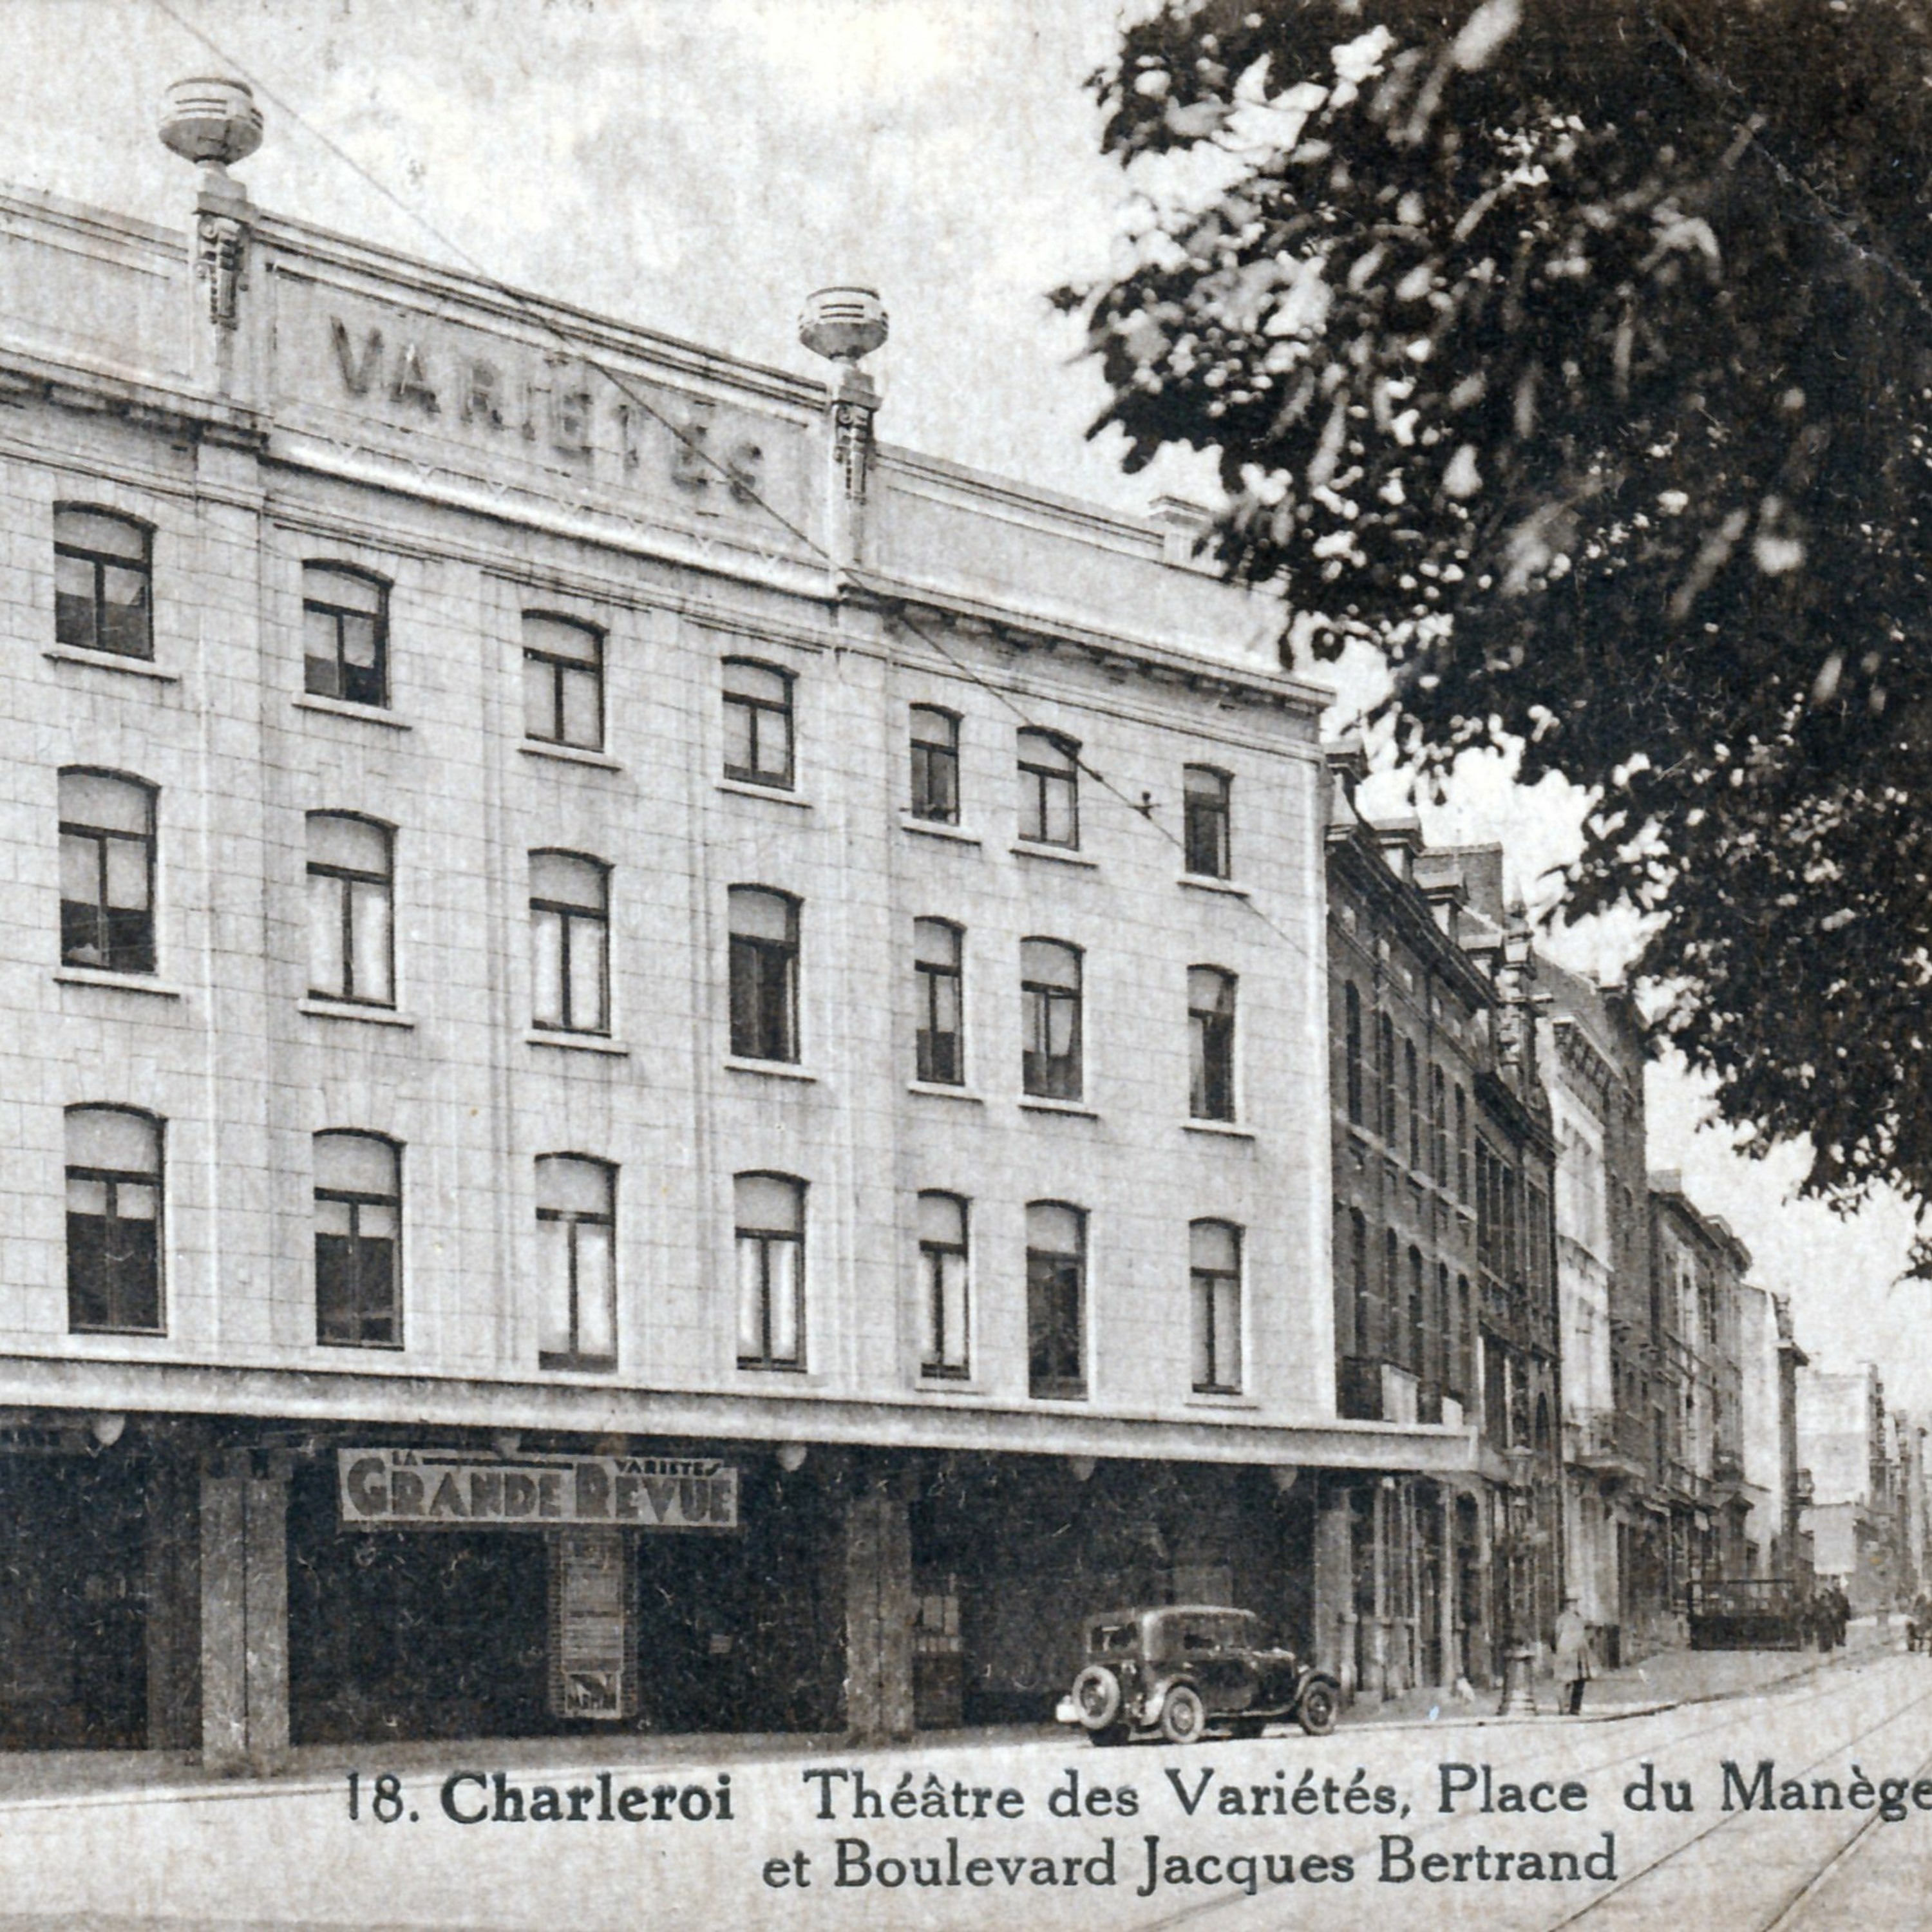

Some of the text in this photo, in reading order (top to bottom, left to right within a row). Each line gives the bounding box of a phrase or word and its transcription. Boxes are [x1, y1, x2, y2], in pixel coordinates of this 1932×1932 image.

[392, 1451, 418, 1466] LA
[348, 1457, 732, 1522] GRANDE REVUE
